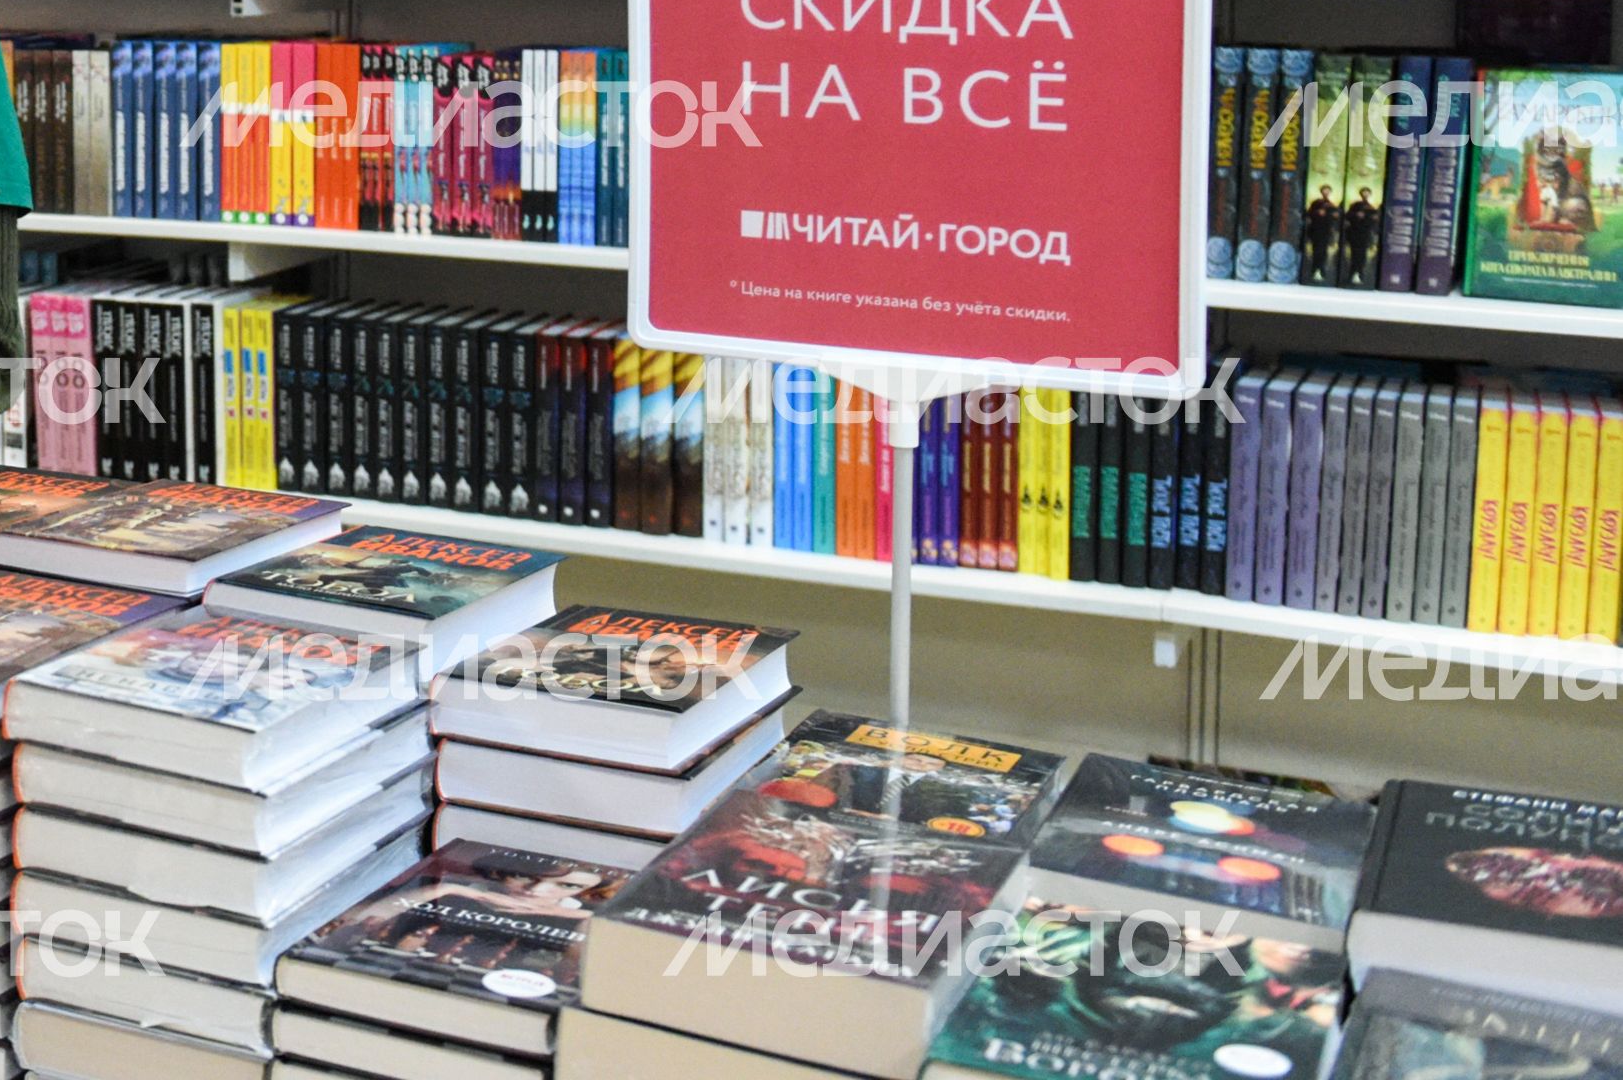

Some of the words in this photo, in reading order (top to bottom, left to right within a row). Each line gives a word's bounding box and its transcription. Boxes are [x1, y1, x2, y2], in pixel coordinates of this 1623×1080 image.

[741, 60, 862, 122] НА
[903, 60, 1070, 132] ВСЁ
[741, 281, 780, 298] Цена
[784, 287, 805, 299] на
[806, 288, 851, 305] книге
[855, 293, 918, 310] указана
[922, 294, 951, 311] без
[955, 299, 1002, 318] учёта
[145, 487, 303, 516] ИВАНОВ
[173, 483, 320, 508] АЛЕКСЕЙ
[349, 542, 519, 572] ИВАНОВ
[367, 531, 533, 563] АЛЕКСЕЙ
[261, 571, 418, 604] ТОБОЛ
[588, 612, 759, 641] АЛЕКСЕЙ
[862, 725, 1013, 764] ВОЛК
[1451, 788, 1569, 812] СТЕФАНИ
[393, 896, 452, 919] ХОД
